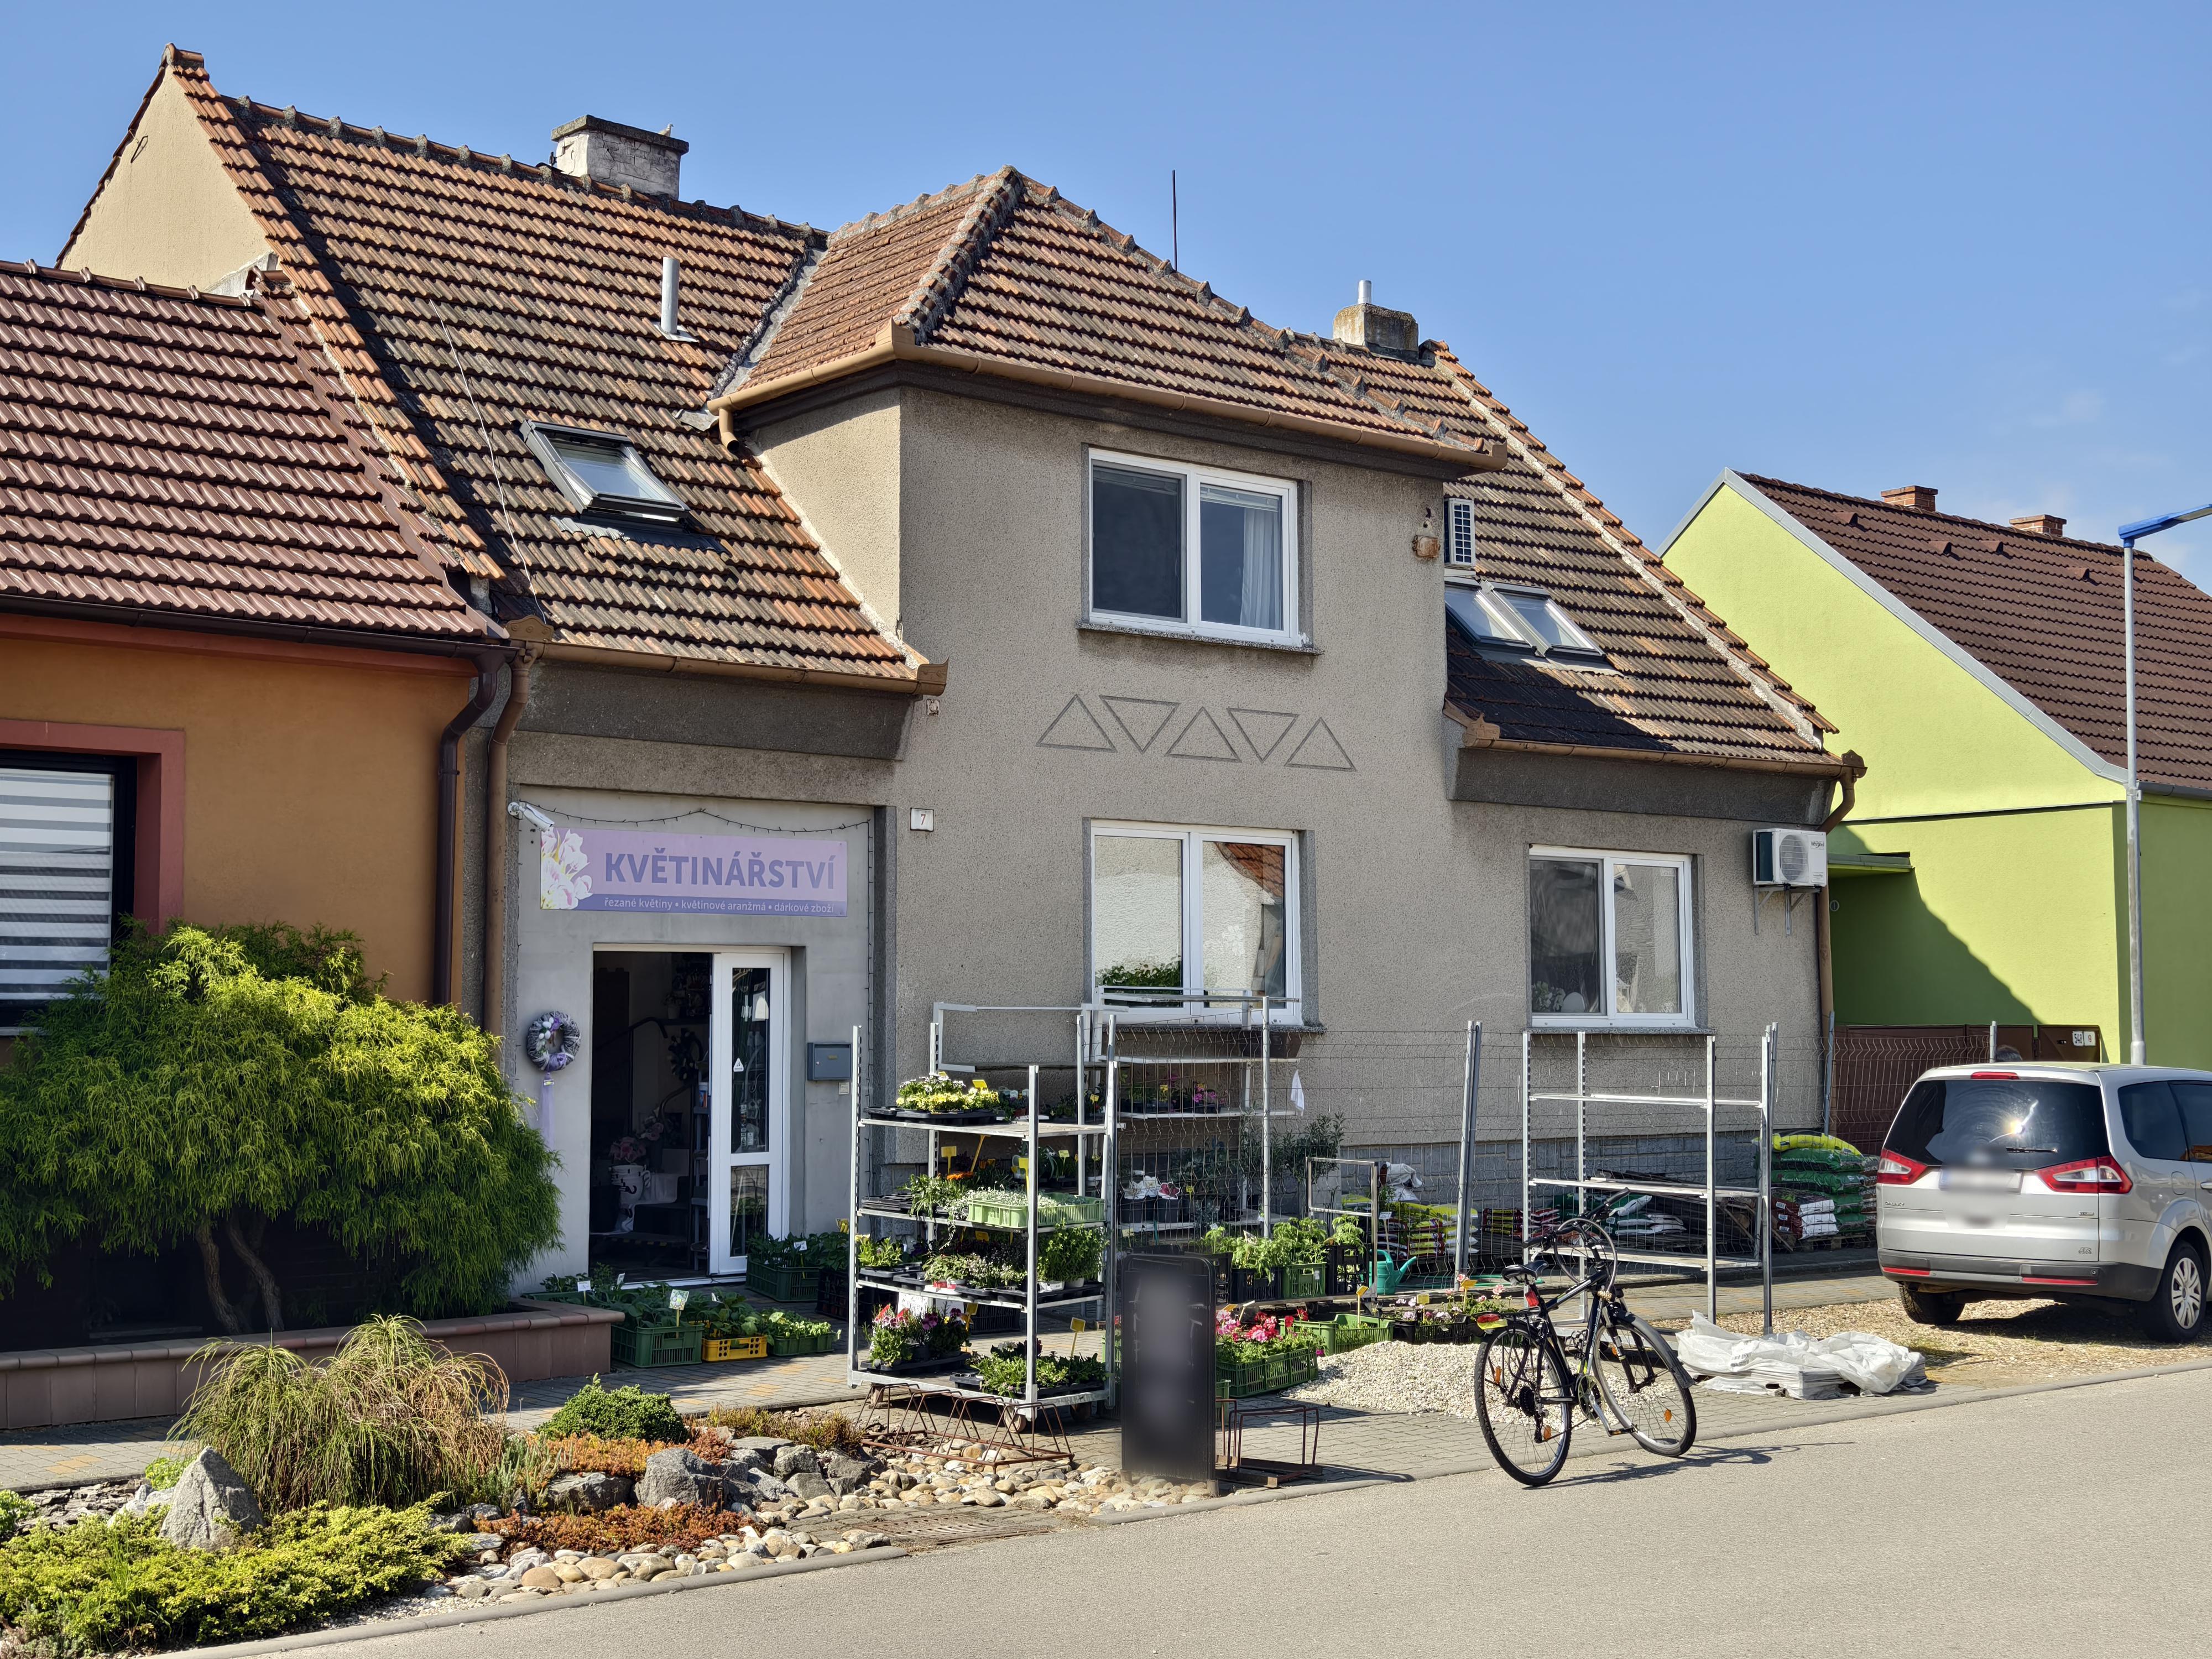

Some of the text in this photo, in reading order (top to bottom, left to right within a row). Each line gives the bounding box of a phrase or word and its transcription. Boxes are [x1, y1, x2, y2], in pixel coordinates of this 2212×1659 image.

[920, 813, 926, 826] 7
[606, 847, 836, 890] KVĚTINÁŘSTVÍ
[604, 898, 834, 913] řezané květiny květinové aranžmá dárkové zboží
[2088, 1034, 2093, 1043] 9
